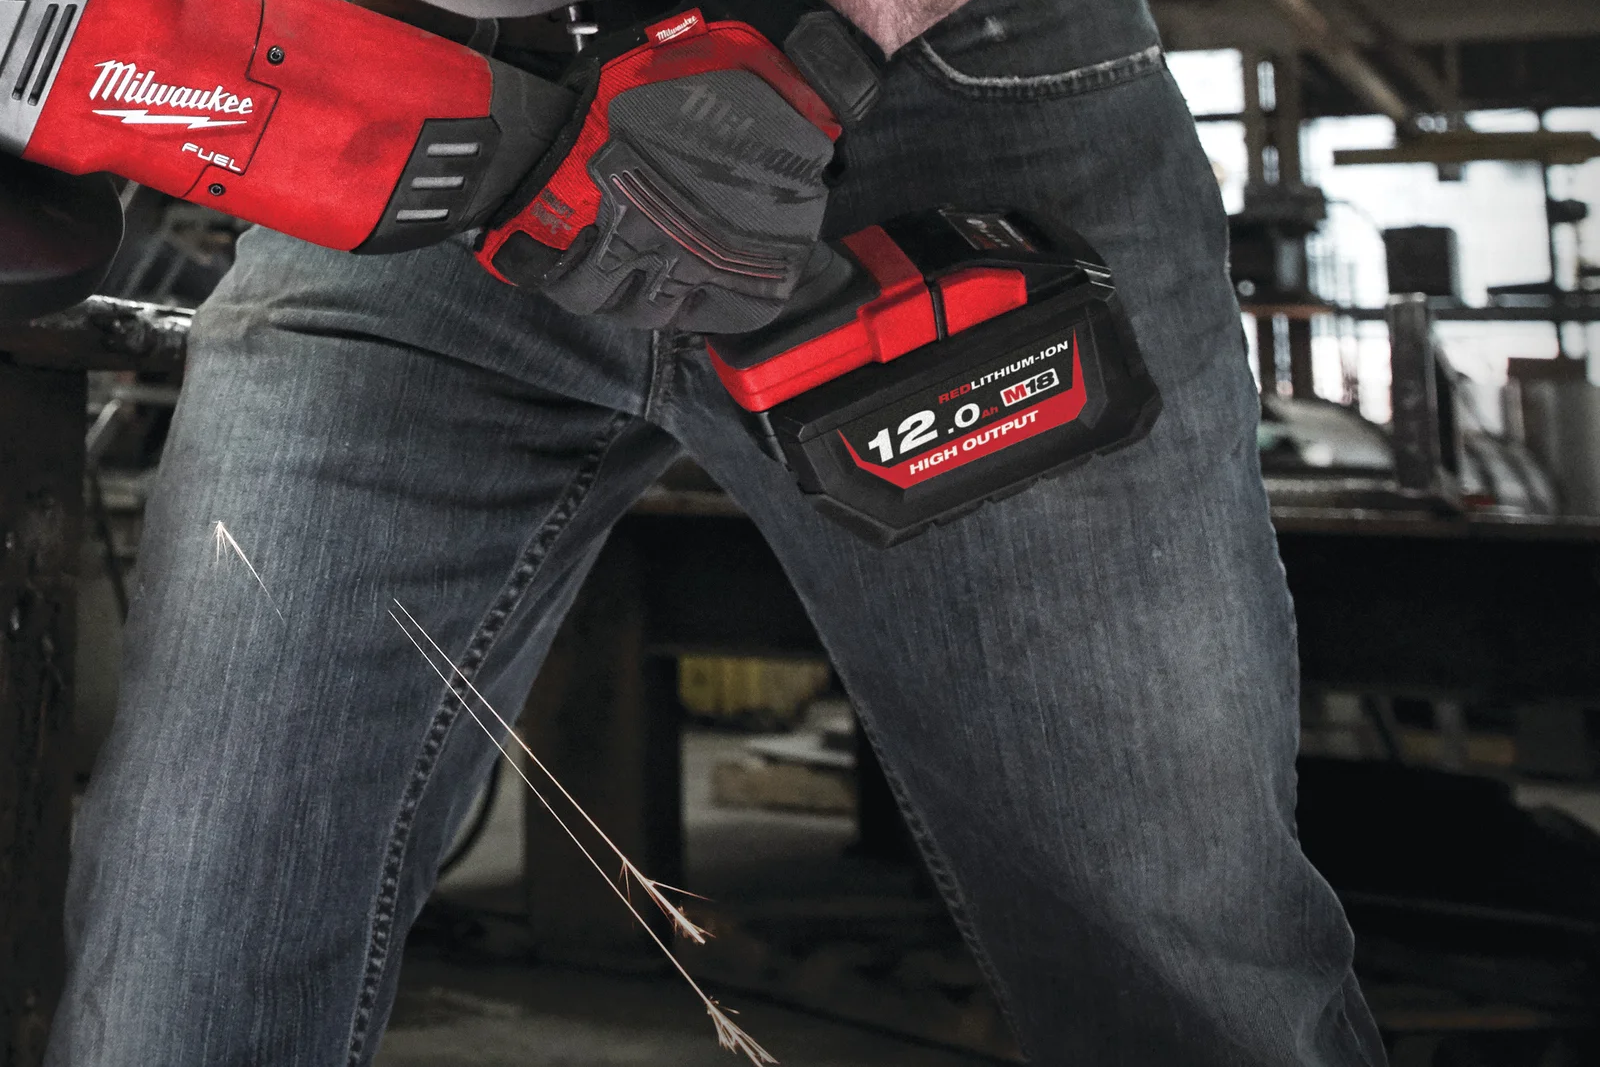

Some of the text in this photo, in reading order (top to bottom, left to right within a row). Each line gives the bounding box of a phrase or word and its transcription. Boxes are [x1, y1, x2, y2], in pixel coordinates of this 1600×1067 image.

[655, 15, 699, 41] Milwaukee
[89, 59, 254, 115] Milwaukee
[181, 141, 242, 173] FUEL
[937, 340, 1069, 404] REDLITHIUM-ION
[1001, 368, 1057, 407] M18
[909, 410, 1039, 475] HIGH OUTPUT
